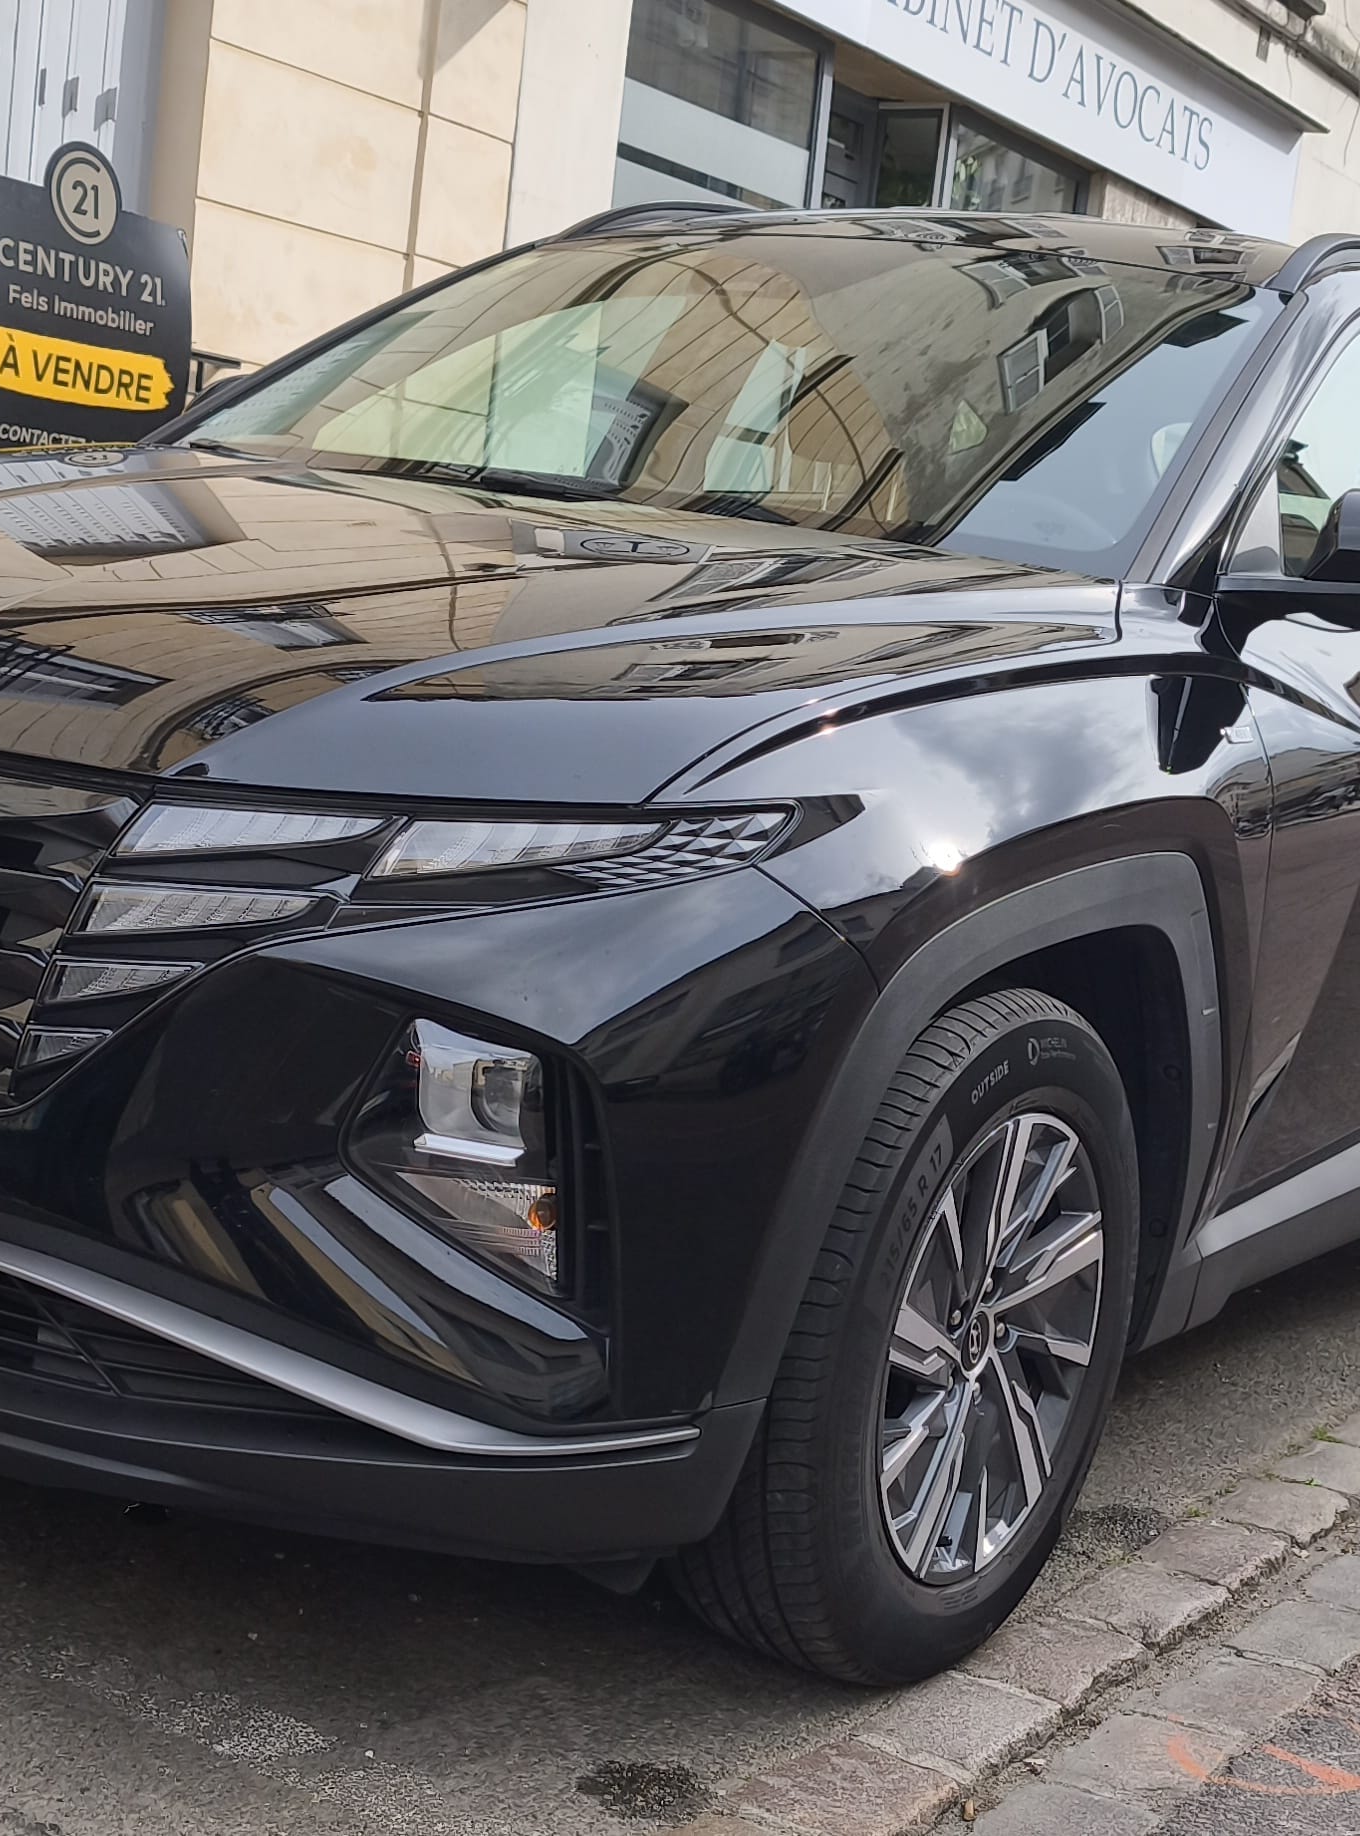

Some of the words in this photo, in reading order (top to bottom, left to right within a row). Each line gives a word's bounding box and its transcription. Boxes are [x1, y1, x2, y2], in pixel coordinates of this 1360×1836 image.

[1028, 18, 1214, 171] D'AVOCATS
[71, 179, 100, 220] 21
[8, 284, 49, 312] Fels
[54, 295, 155, 336] Immobilier
[32, 350, 154, 404] VENDRE
[969, 1058, 1010, 1105] OUTSIDE
